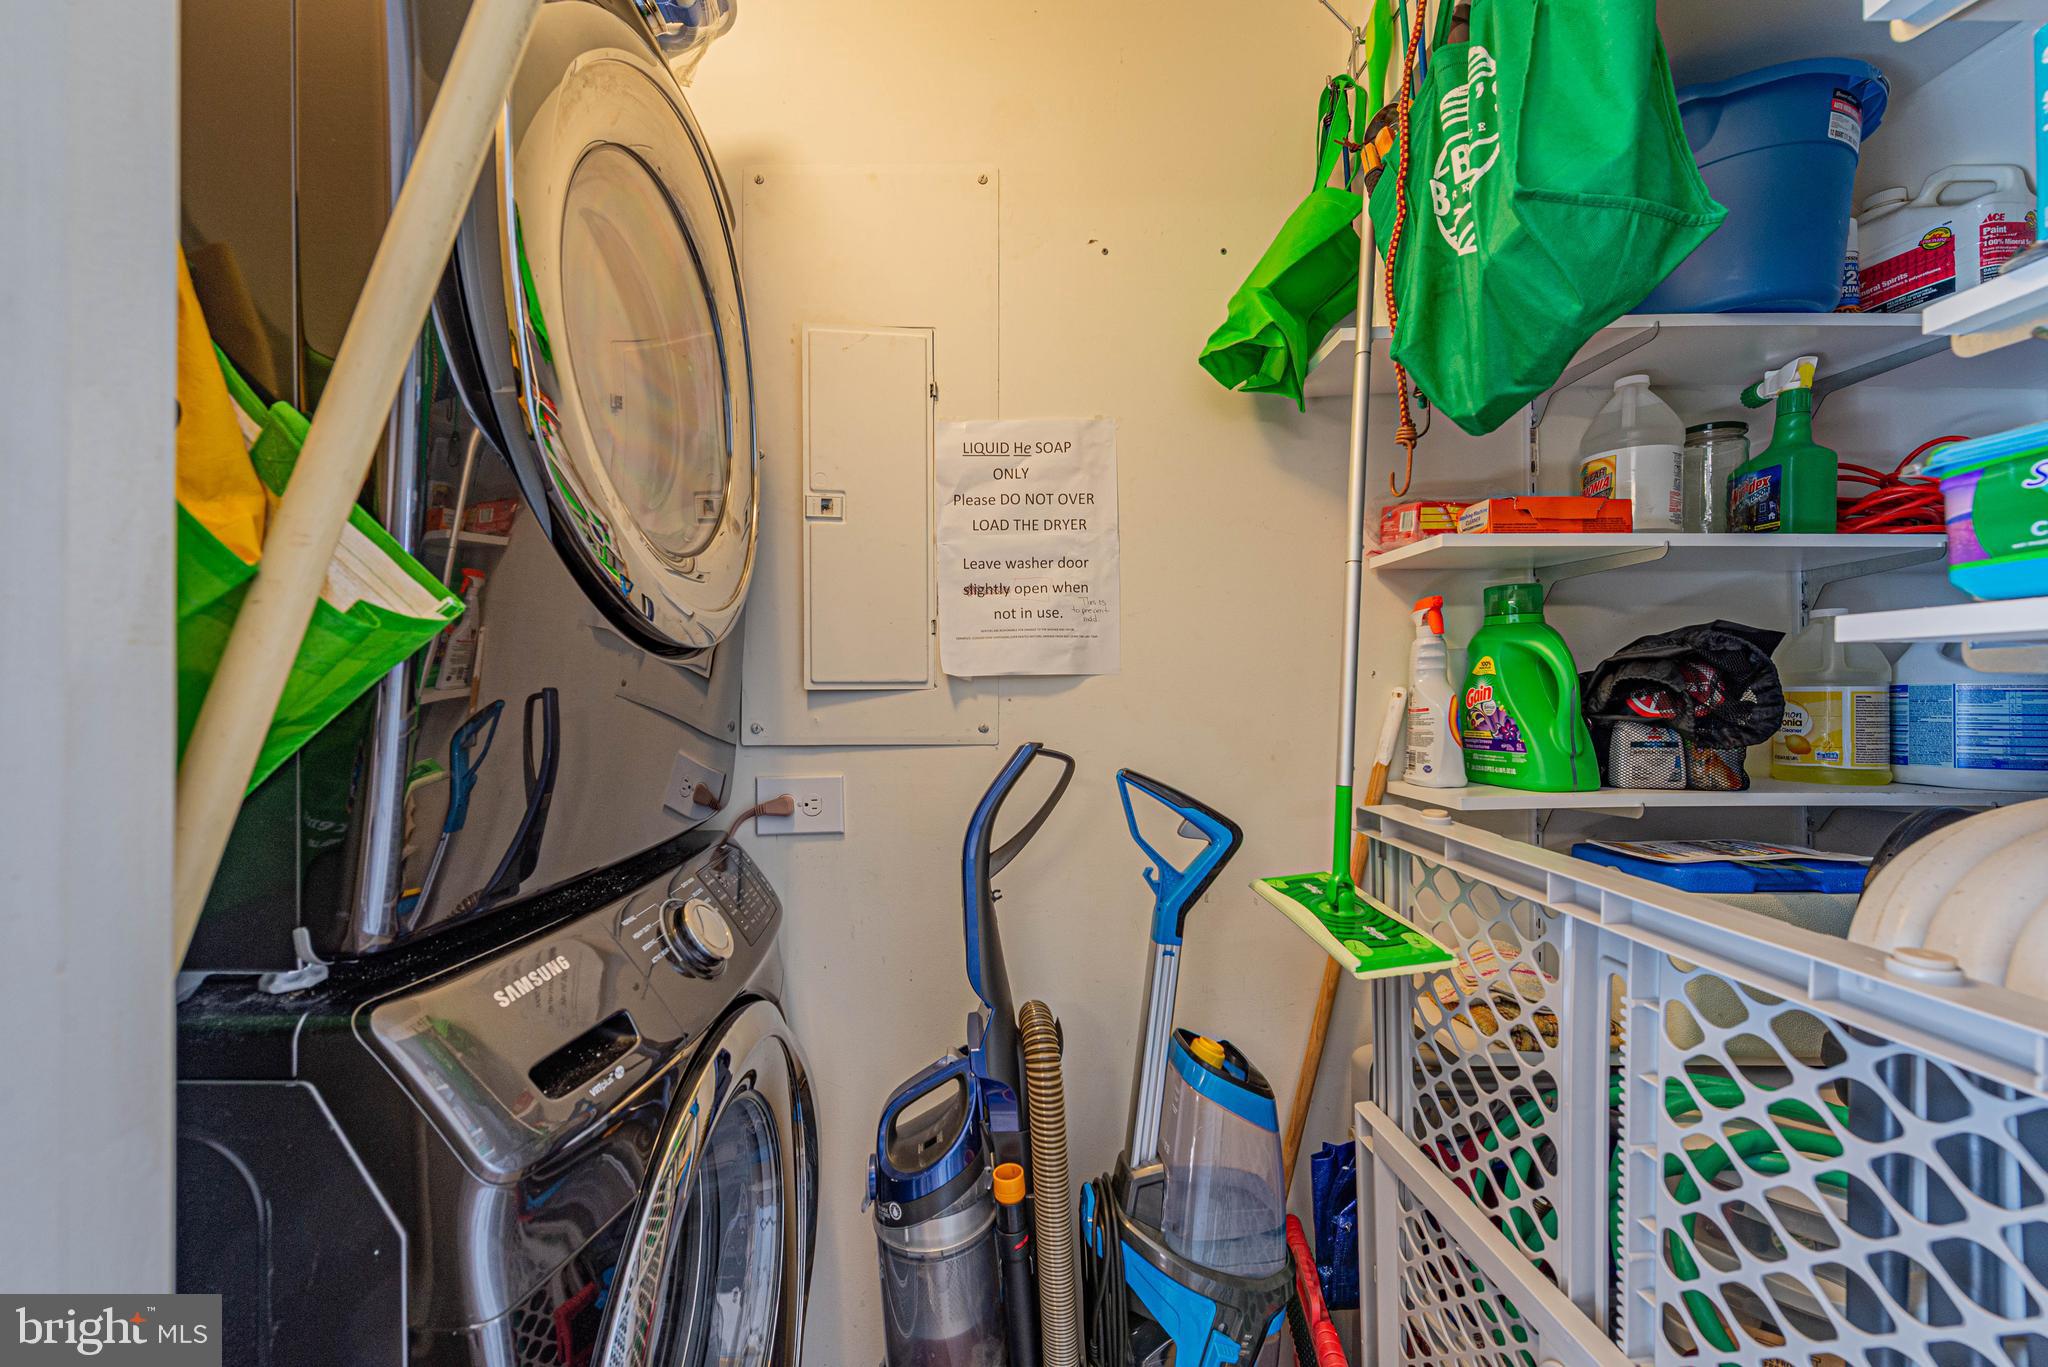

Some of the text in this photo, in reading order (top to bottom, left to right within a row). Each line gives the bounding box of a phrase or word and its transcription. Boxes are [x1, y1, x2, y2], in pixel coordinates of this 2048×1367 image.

[1983, 212, 2006, 224] ACE
[1983, 226, 2007, 235] Paint
[1983, 239, 2003, 247] 100%
[1861, 283, 1880, 297] neral
[1881, 272, 1909, 288] Spirits
[963, 441, 1072, 456] LIQUID He SOAP
[993, 468, 1029, 480] ONLY
[953, 493, 1095, 506] Please DO NOT OVER
[972, 519, 1087, 531] LOAD THE DRYER
[963, 556, 1089, 570] Leave washer door
[963, 581, 1089, 597] slightly open when
[994, 607, 1063, 620] not in use.
[1466, 685, 1492, 709] Gain
[1783, 711, 1802, 719] mon
[1782, 719, 1803, 727] onia
[493, 955, 571, 1008] SAMSUNG
